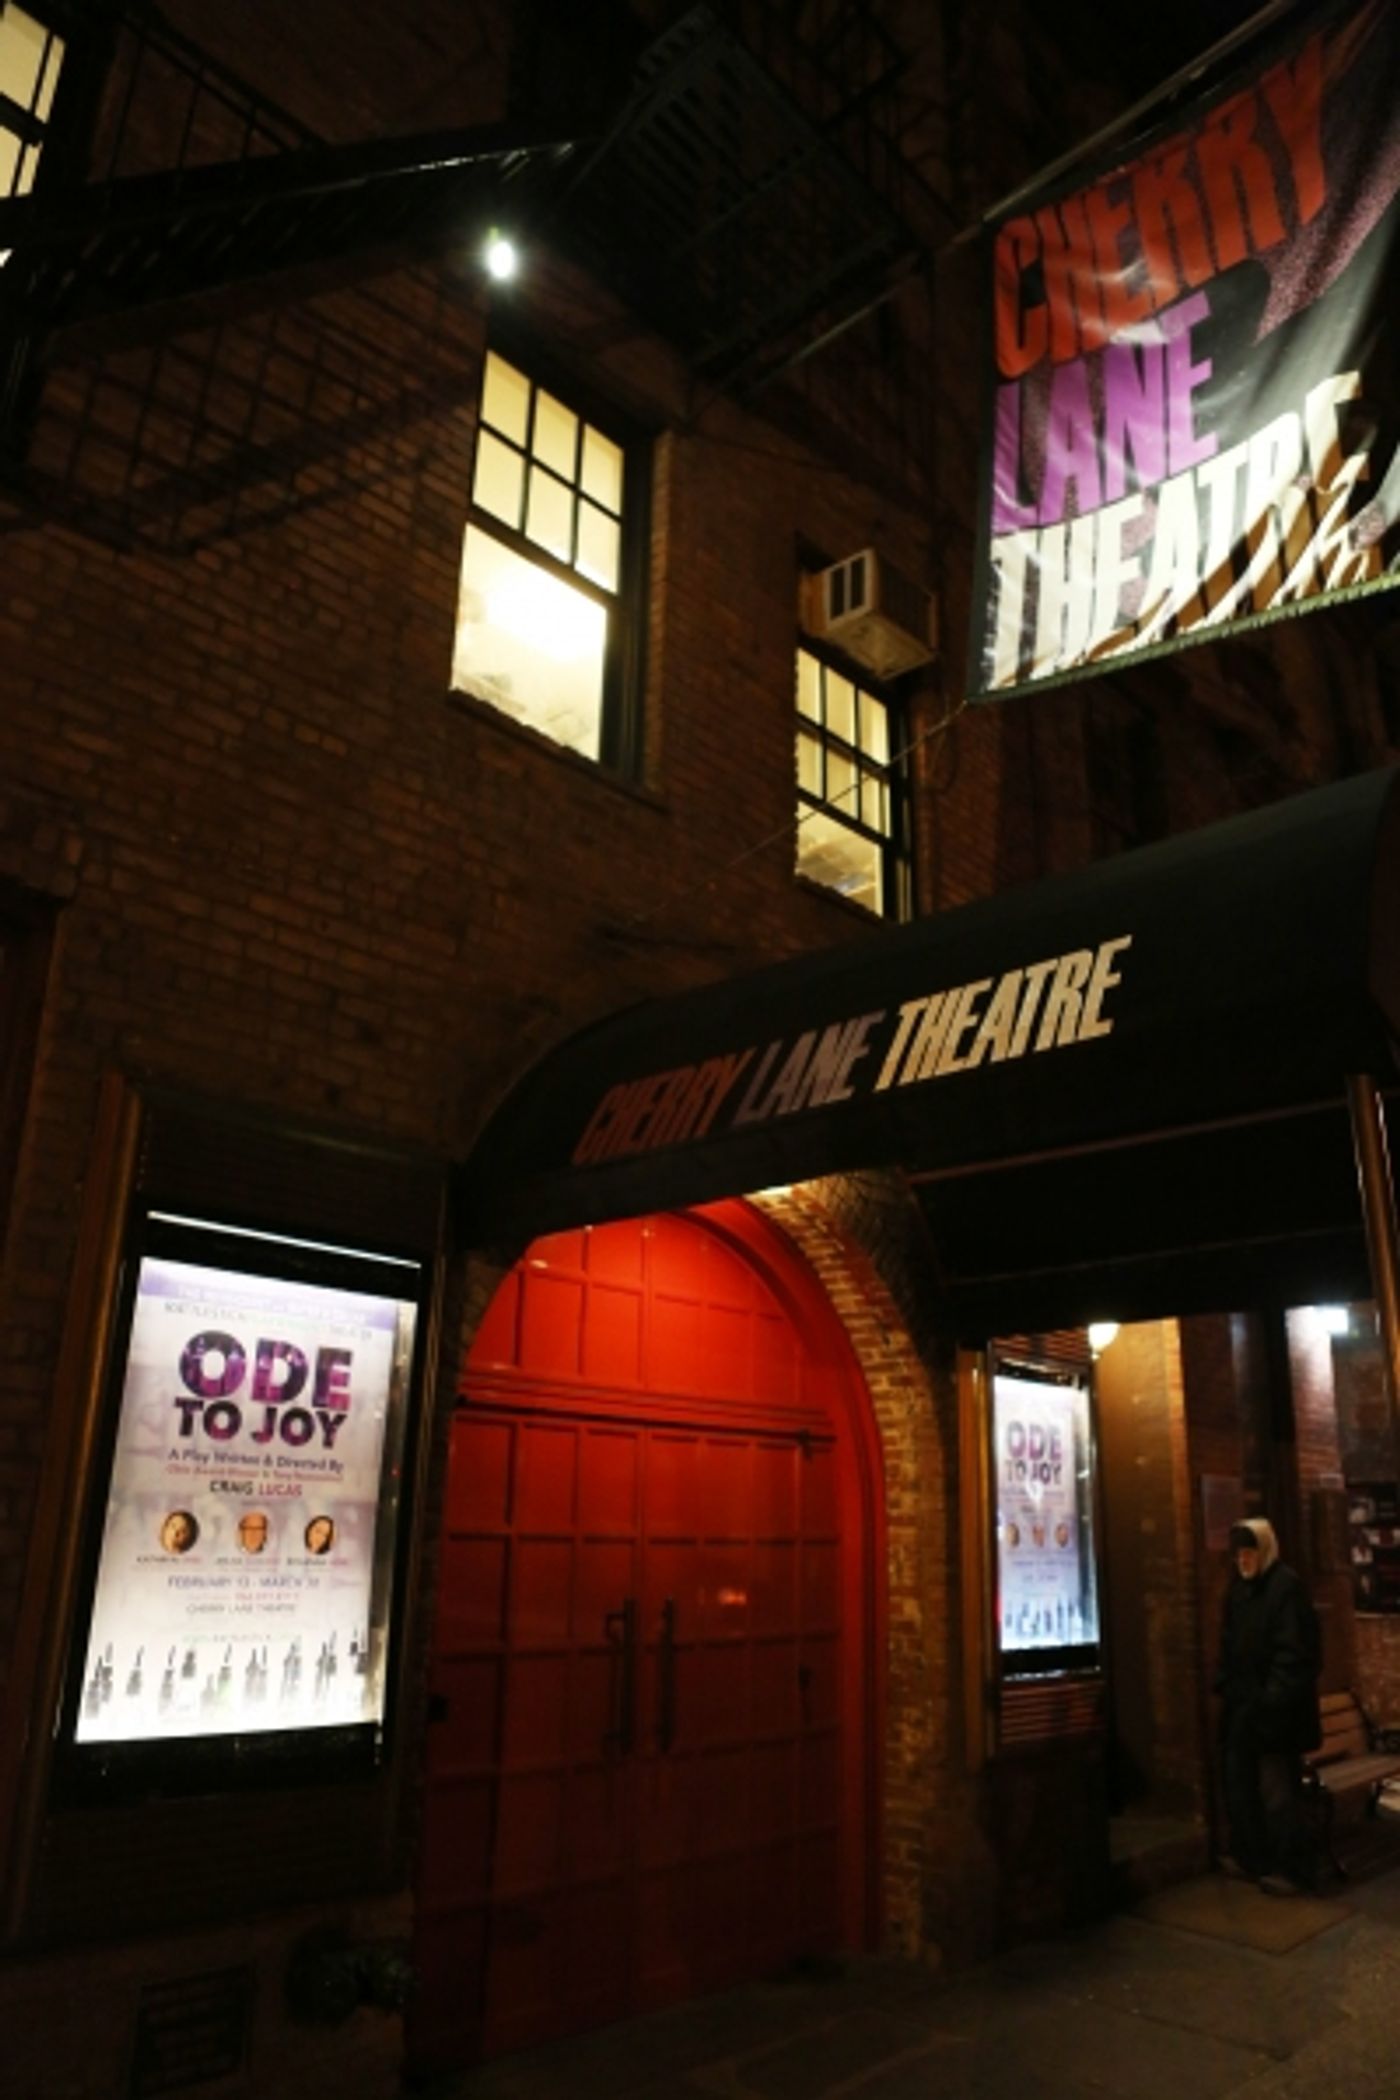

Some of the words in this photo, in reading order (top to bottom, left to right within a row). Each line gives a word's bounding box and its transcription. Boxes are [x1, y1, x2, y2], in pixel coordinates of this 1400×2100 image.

[992, 30, 1327, 380] CHERRY
[990, 290, 1220, 538] LANE
[570, 1046, 757, 1166] CHERRY
[730, 1010, 886, 1129] LANE
[872, 934, 1133, 1094] THEATRE
[178, 1329, 354, 1413] ODE
[174, 1397, 243, 1442] TO
[250, 1406, 348, 1450] JOY
[1005, 1420, 1063, 1462] ODE
[167, 1448, 181, 1461] A
[183, 1449, 209, 1464] Play
[329, 1458, 345, 1473] By
[1004, 1459, 1027, 1484] TO
[1029, 1462, 1063, 1487] JOY
[209, 1480, 254, 1495] CRAIG
[258, 1482, 304, 1497] LUCAS
